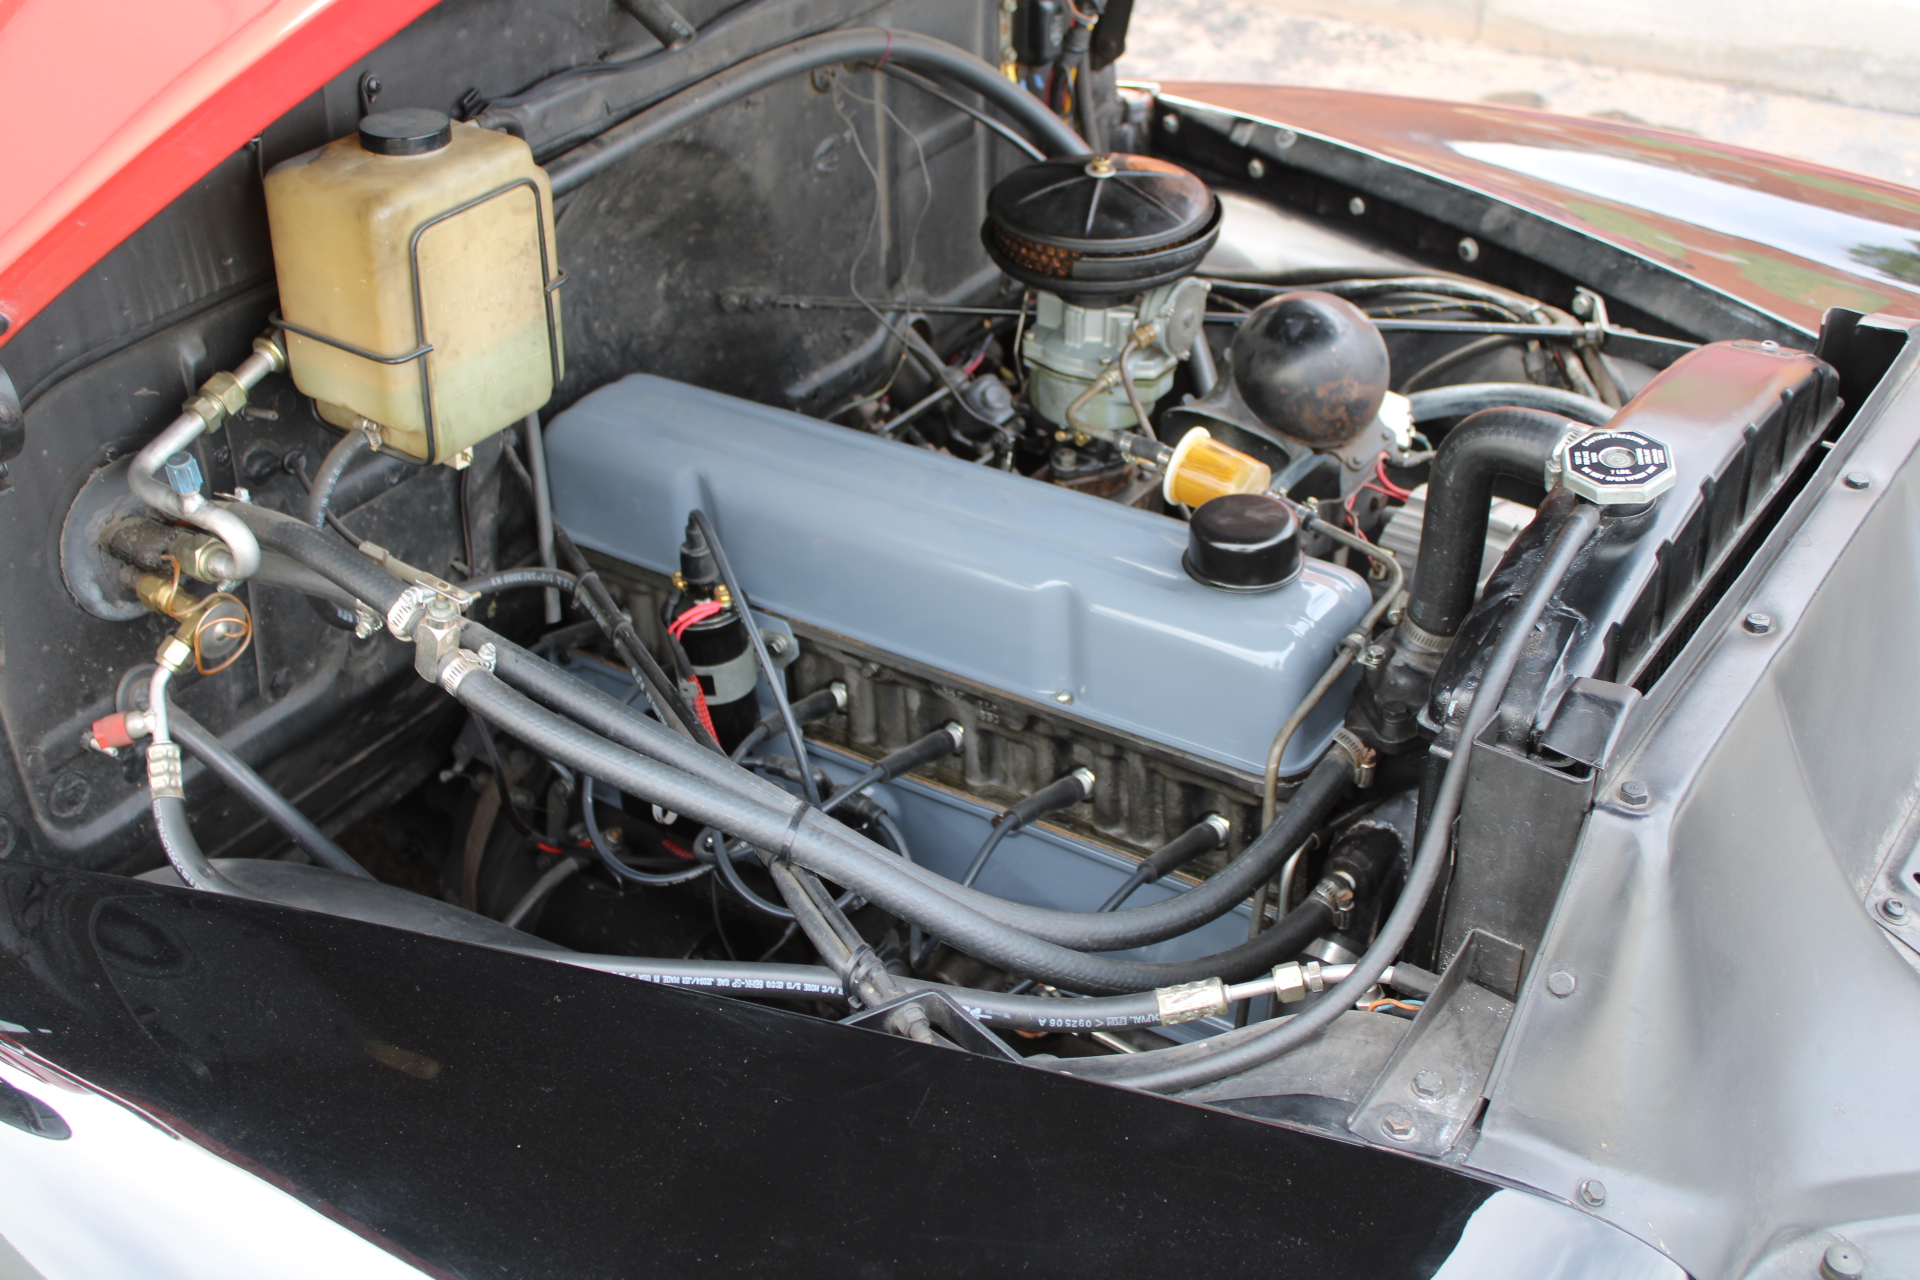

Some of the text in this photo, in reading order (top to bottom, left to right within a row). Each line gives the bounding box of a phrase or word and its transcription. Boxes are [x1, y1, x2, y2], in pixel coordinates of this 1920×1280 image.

[1581, 434, 1649, 447] CAUTION PRESSURE
[1580, 466, 1593, 474] DO
[1589, 471, 1606, 480] NOT
[1625, 471, 1649, 481] WHEN
[662, 975, 680, 984] MADE
[803, 983, 820, 992] HOSE
[821, 985, 836, 994] A/C
[1106, 1016, 1127, 1026] EPDM
